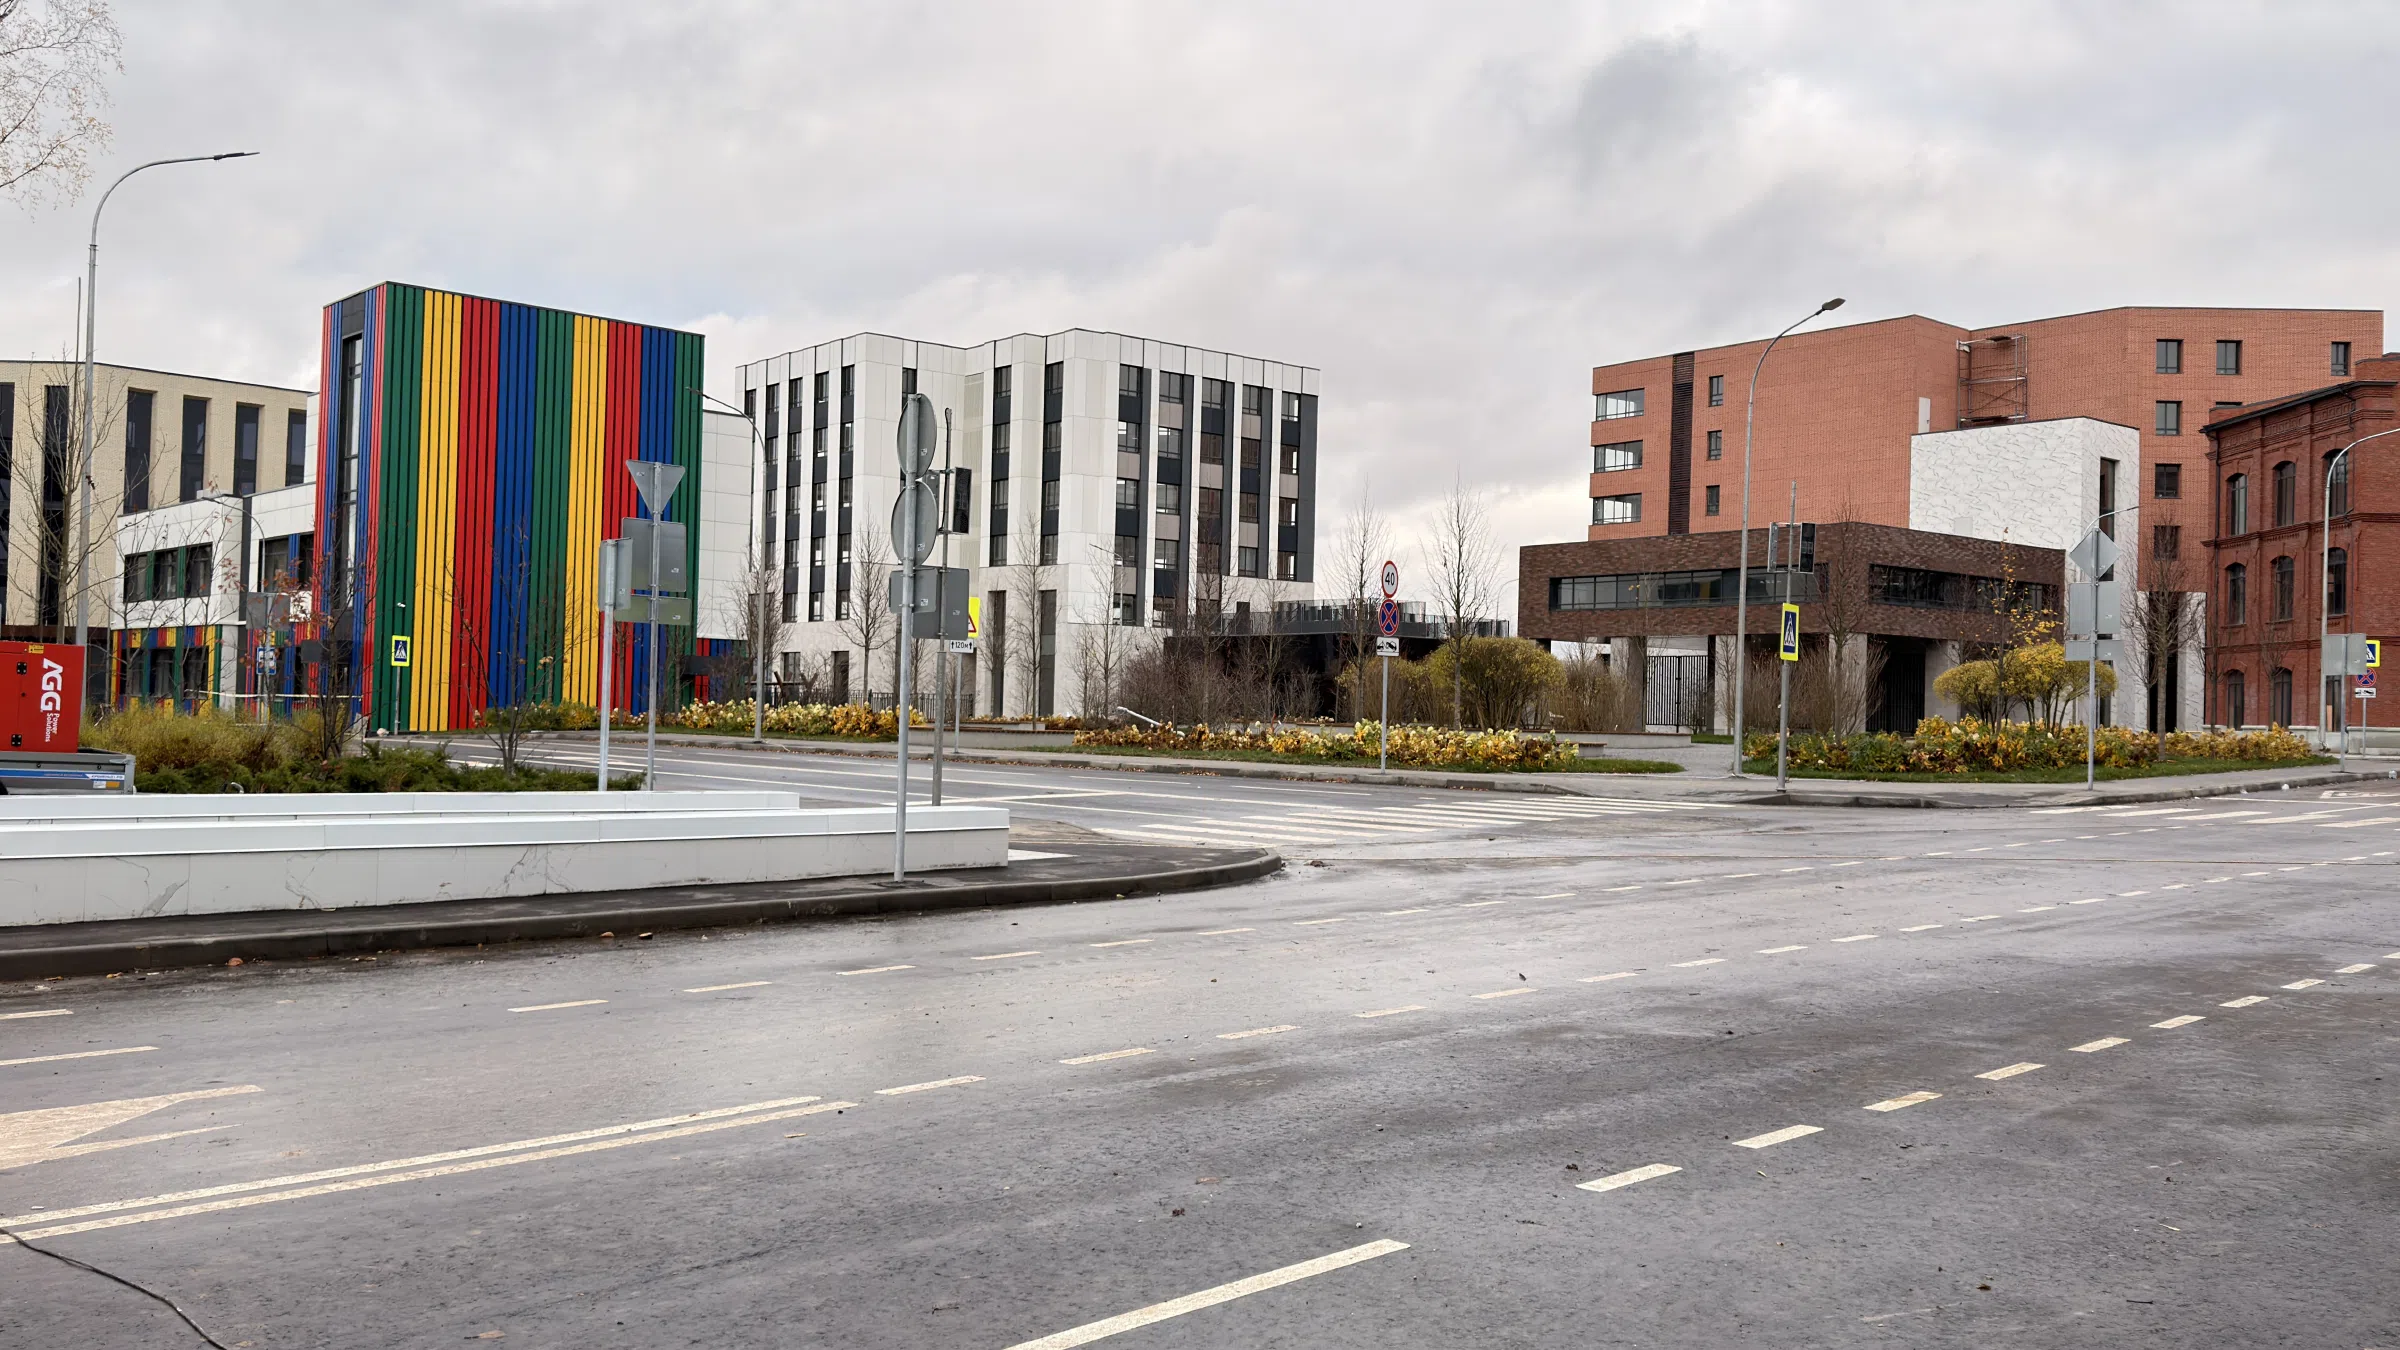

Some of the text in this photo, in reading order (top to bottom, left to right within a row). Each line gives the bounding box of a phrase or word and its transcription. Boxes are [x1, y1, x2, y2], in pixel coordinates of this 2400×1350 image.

[1385, 572, 1395, 586] 40
[40, 657, 63, 711] AGG
[45, 712, 54, 742] Solutions
[52, 712, 60, 735] Power
